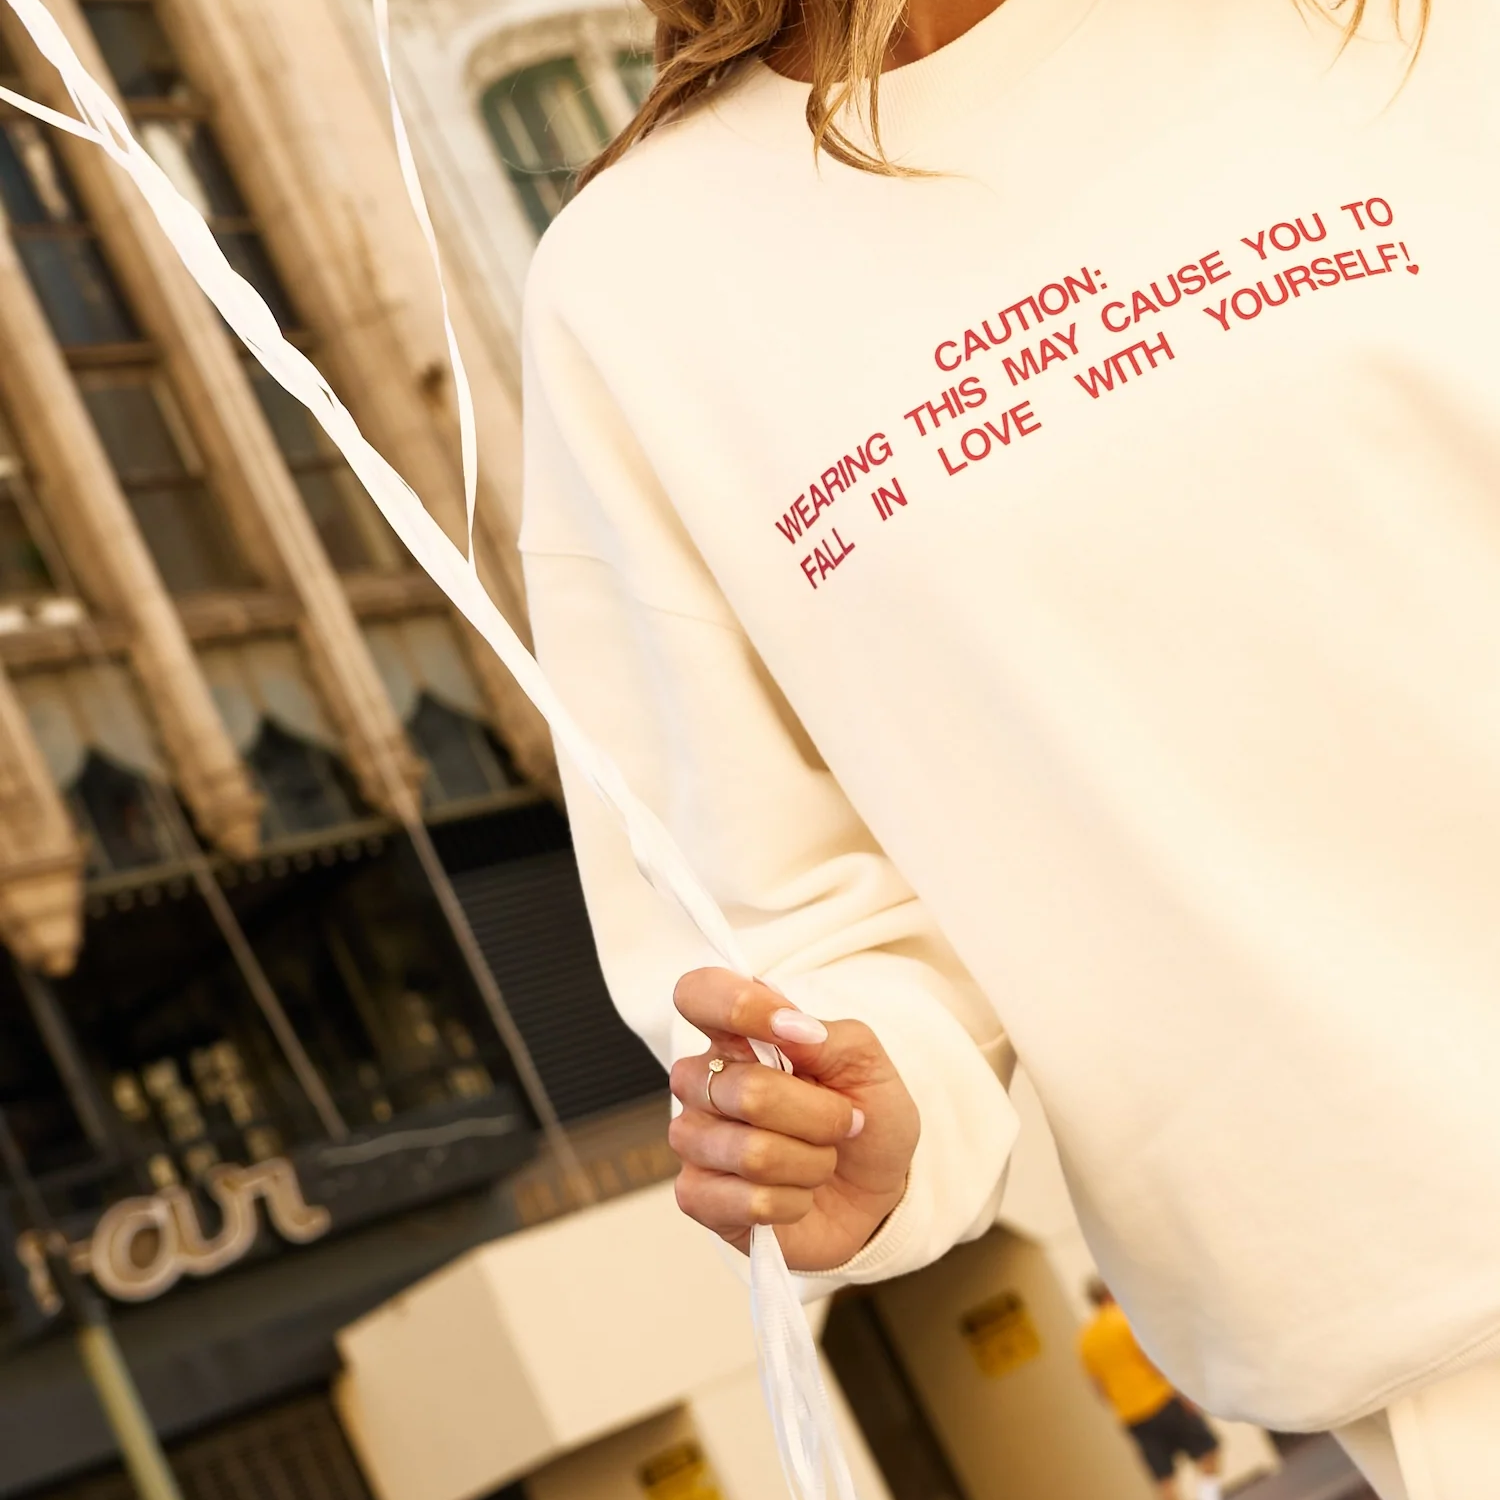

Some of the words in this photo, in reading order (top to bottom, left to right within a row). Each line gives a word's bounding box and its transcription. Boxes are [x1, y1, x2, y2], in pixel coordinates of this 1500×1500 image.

[776, 432, 893, 544] WEARING
[904, 376, 987, 436] THIS
[1002, 324, 1078, 386] MAY
[1101, 251, 1231, 332] CAUSE
[1241, 213, 1326, 260] YOU
[1341, 197, 1393, 230] TO
[800, 530, 855, 588] FALL
[871, 478, 907, 521] IN
[938, 401, 1041, 476] LOVE
[1074, 332, 1174, 399] WITH
[1204, 242, 1419, 331] YOURSELF!
[935, 267, 1107, 372] CAUTION:
